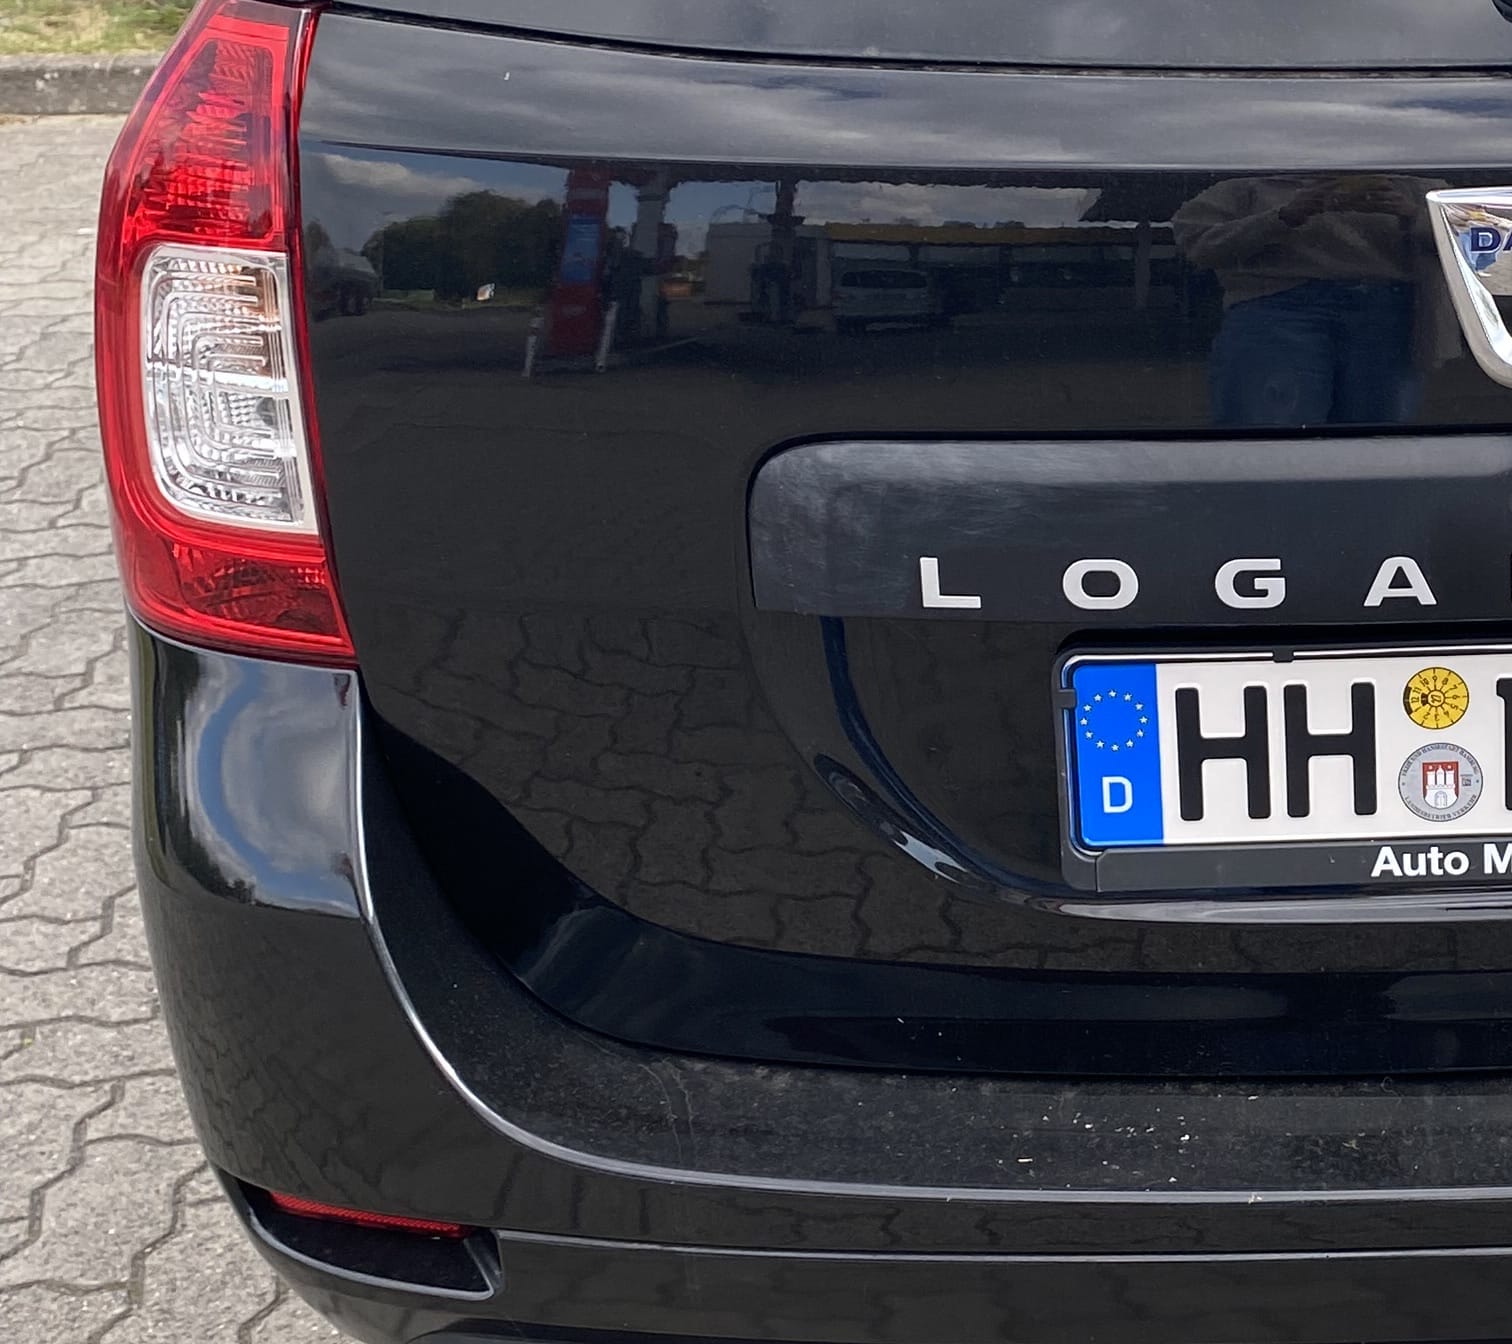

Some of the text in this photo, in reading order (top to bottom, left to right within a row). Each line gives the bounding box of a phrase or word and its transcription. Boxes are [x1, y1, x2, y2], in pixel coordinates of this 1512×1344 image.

[1174, 681, 1377, 822] HH
[1102, 775, 1134, 814] D
[1370, 845, 1470, 877] Auto
